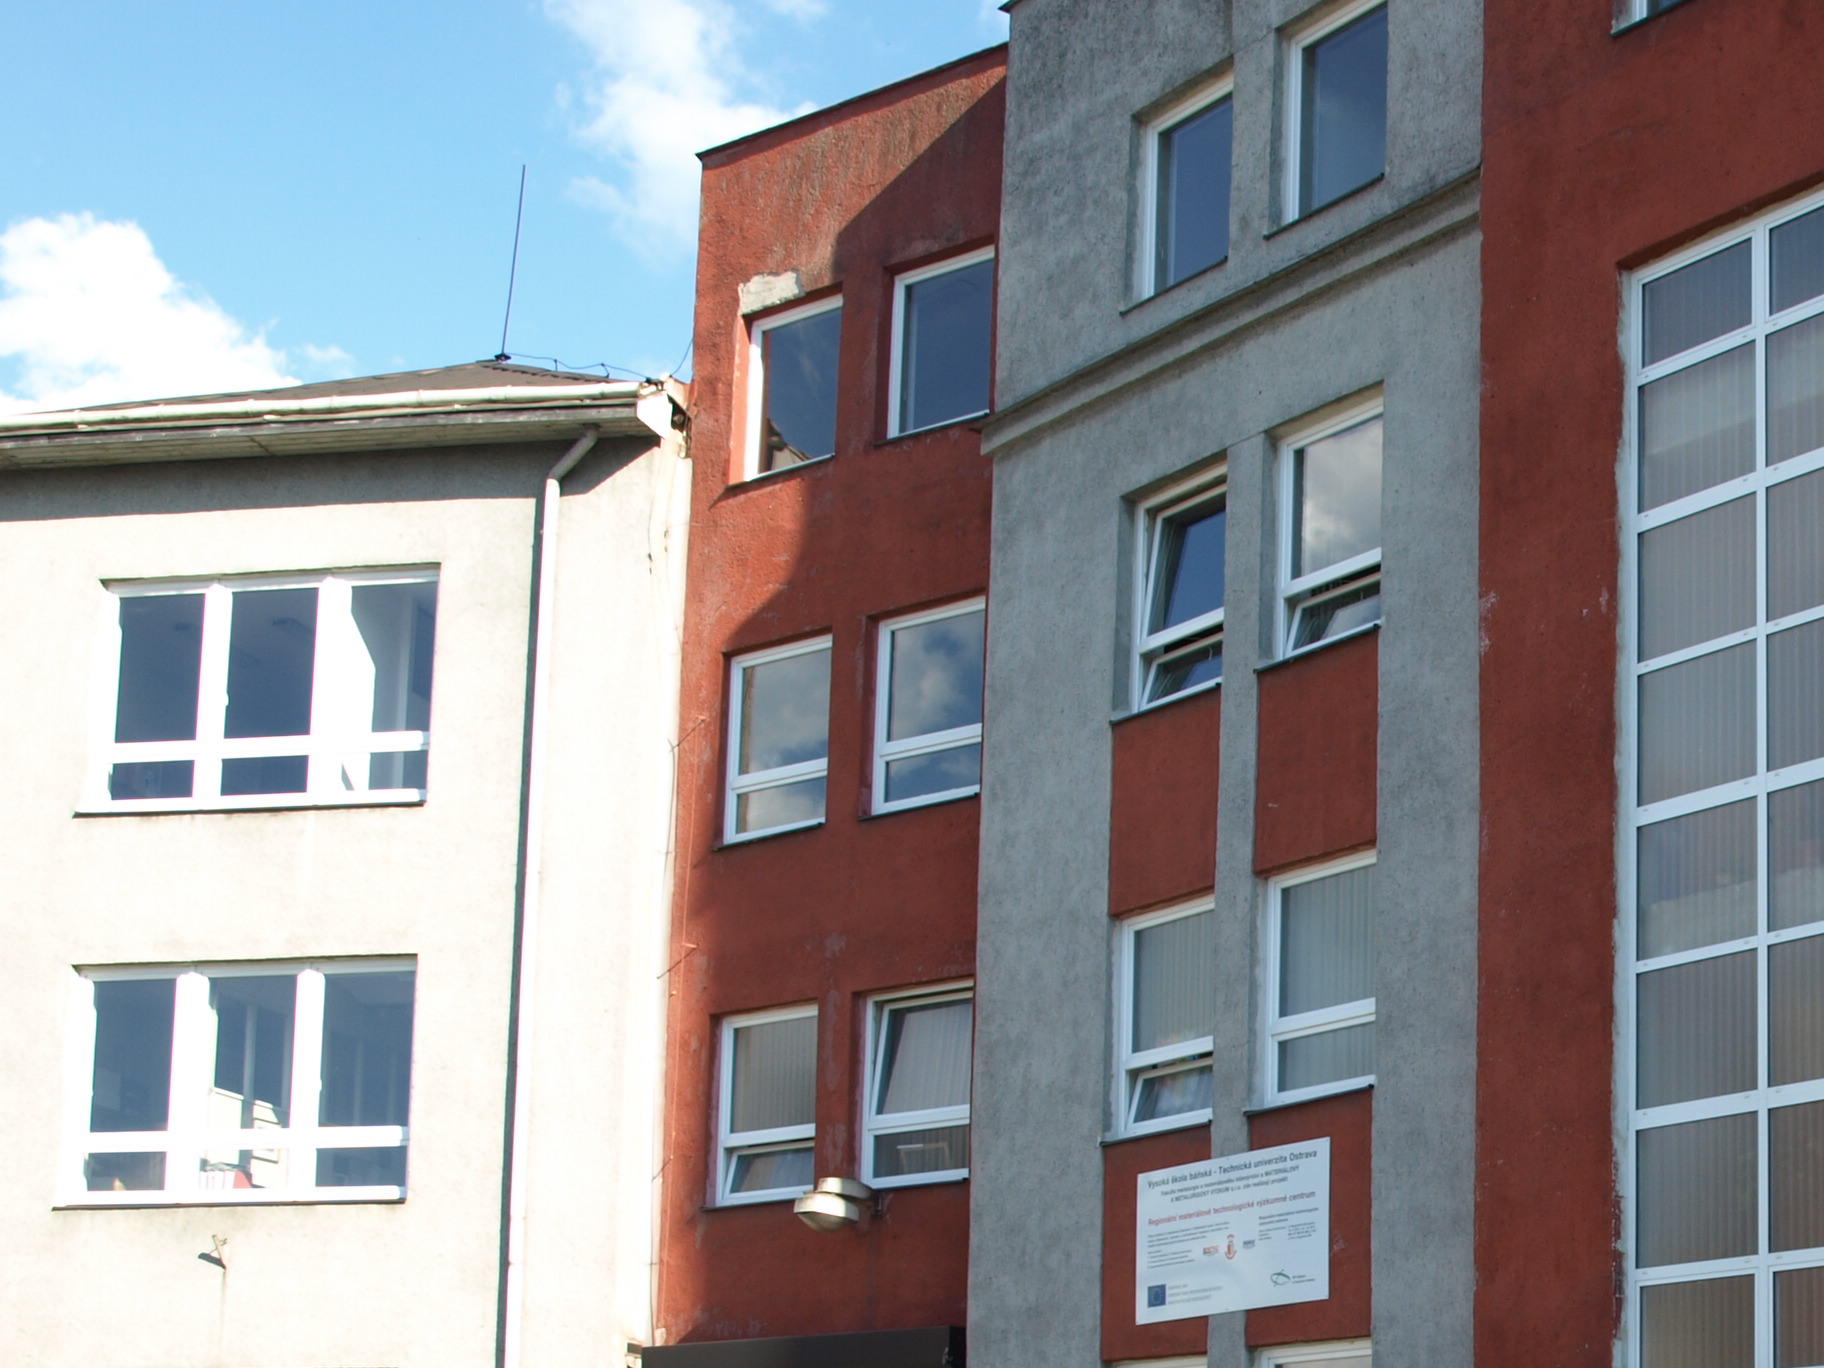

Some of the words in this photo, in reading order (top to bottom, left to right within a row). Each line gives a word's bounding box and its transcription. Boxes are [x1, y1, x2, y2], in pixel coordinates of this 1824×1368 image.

[1148, 1177, 1170, 1189] Vysoká
[1171, 1173, 1188, 1184] škola
[1218, 1160, 1252, 1175] Technická
[1253, 1154, 1288, 1168] univerzita
[1289, 1150, 1318, 1162] Ostrava
[1288, 1191, 1316, 1202] centrum
